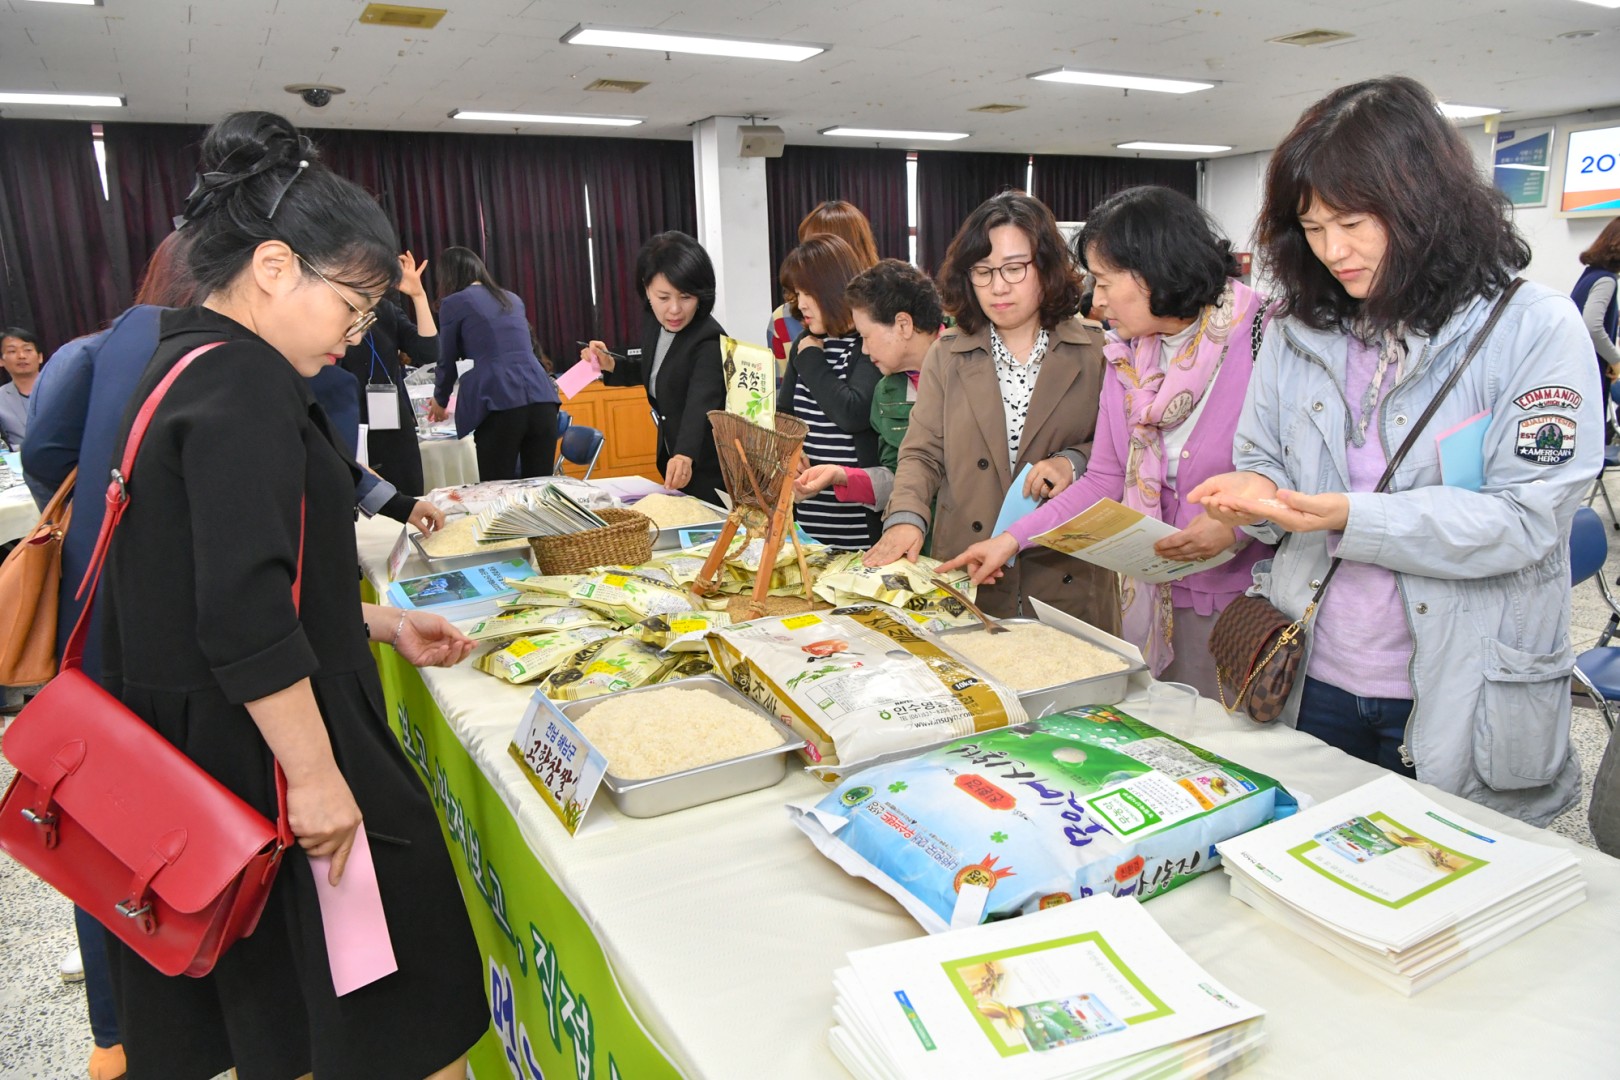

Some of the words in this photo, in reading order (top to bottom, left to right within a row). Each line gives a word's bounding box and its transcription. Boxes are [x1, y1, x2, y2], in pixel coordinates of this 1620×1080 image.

[1580, 153, 1620, 174] 20
[1519, 389, 1580, 407] COMMANDO
[1537, 455, 1560, 463] HERO
[955, 679, 975, 691] 10kg
[965, 778, 1004, 804] 친환경
